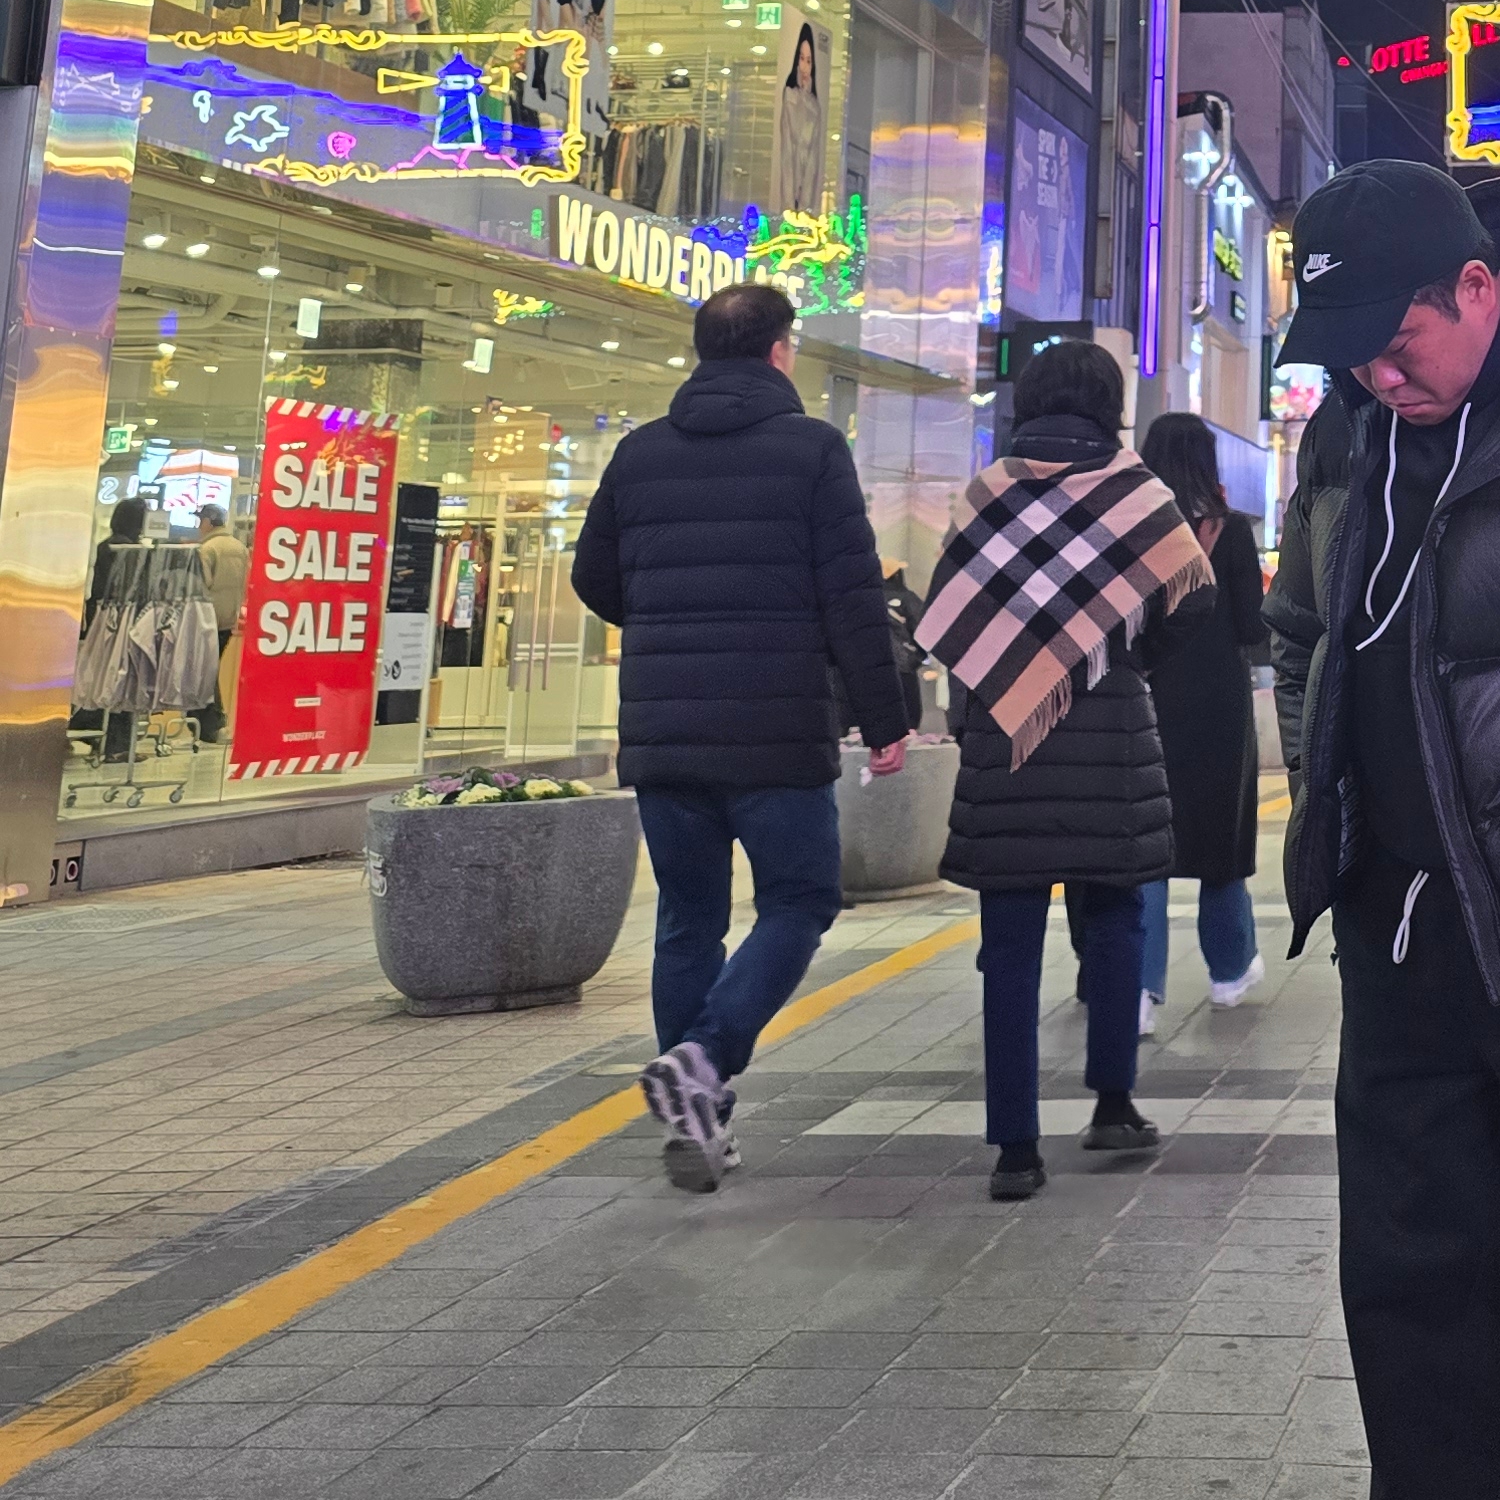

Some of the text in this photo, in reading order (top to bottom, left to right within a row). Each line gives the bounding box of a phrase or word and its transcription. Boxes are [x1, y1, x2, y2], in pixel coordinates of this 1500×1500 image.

[1369, 35, 1430, 74] OTTE
[558, 194, 804, 330] WONDERPE
[1307, 253, 1331, 269] NIKE
[271, 454, 380, 513] SALE
[264, 527, 374, 582] SALE
[258, 600, 368, 656] SALE
